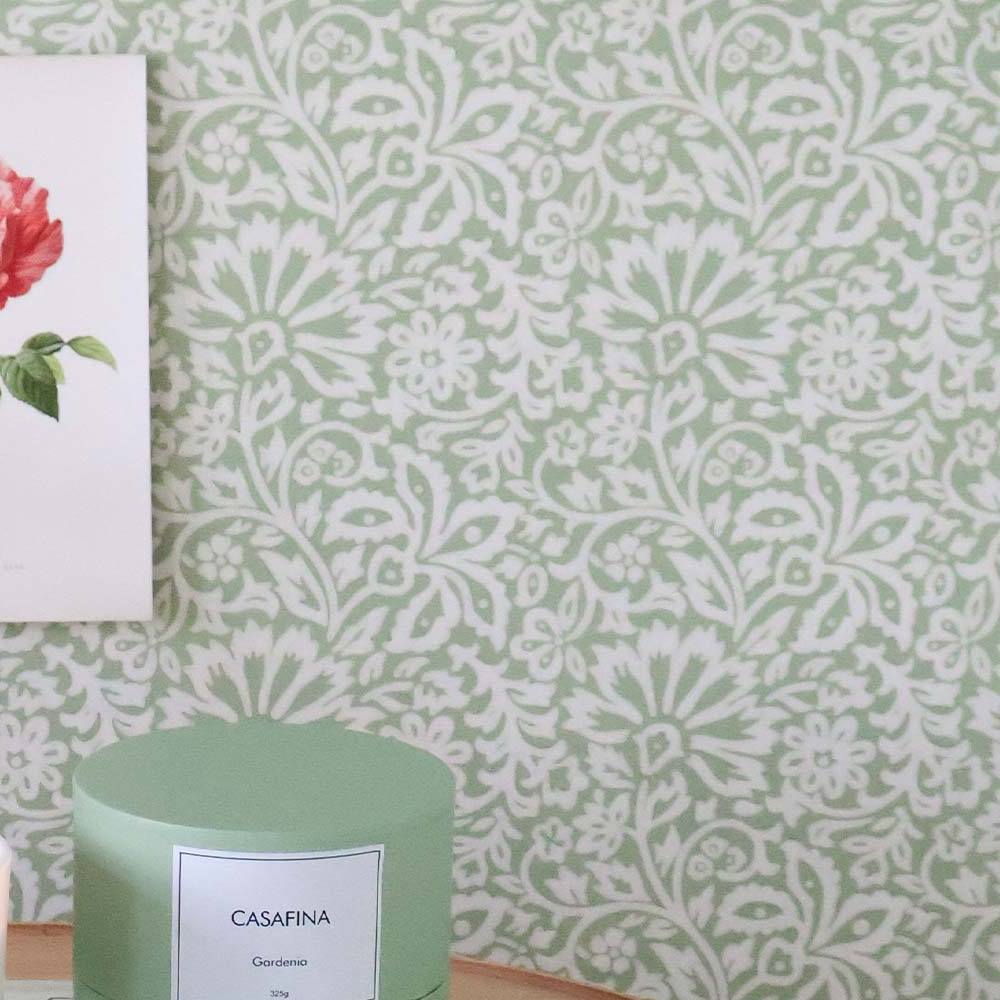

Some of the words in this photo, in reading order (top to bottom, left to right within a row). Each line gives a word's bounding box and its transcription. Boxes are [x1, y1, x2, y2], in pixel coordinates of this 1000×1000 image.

[230, 909, 331, 928] CASAFINA
[251, 956, 308, 968] Gardenia
[269, 990, 290, 999] 325g
